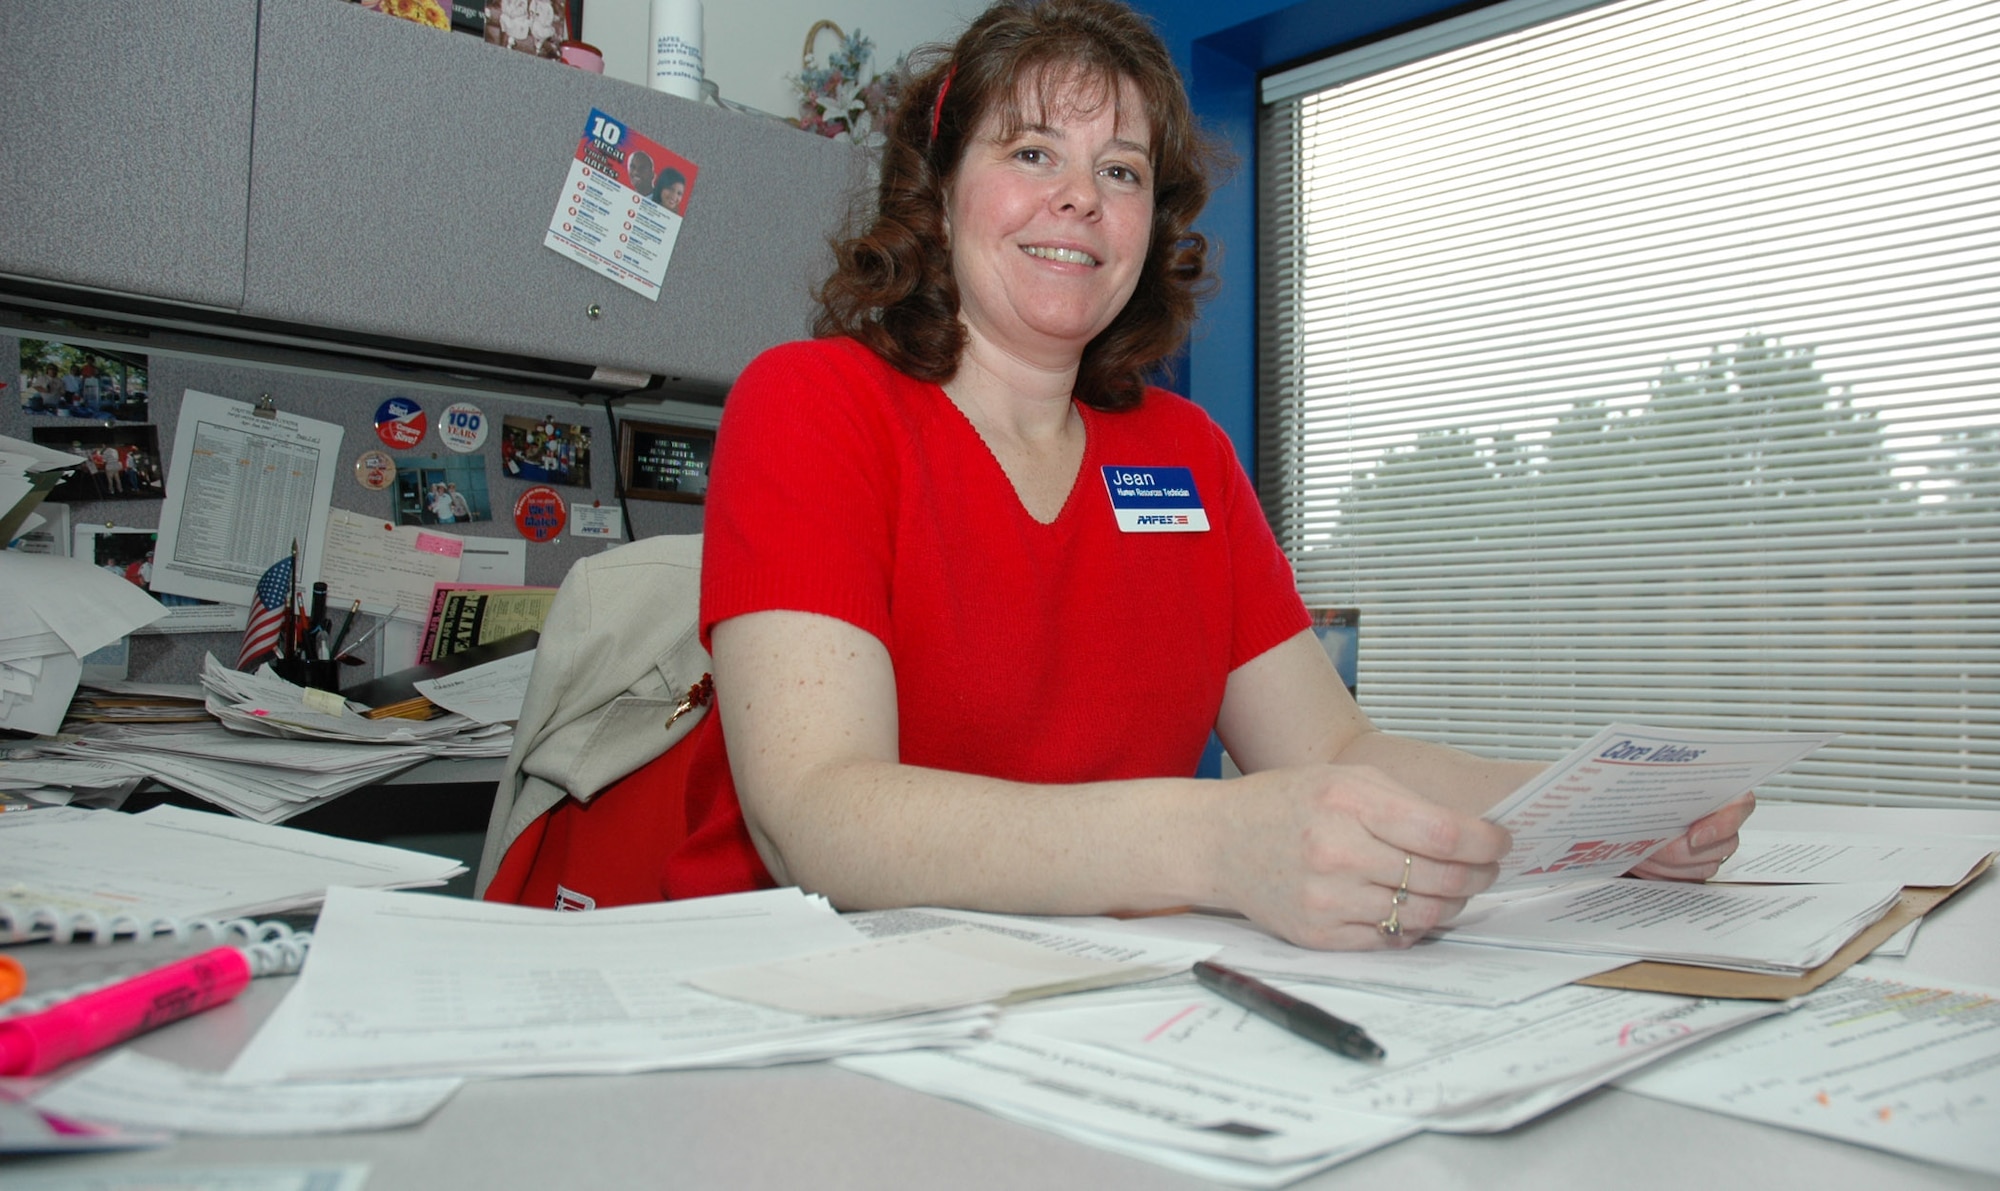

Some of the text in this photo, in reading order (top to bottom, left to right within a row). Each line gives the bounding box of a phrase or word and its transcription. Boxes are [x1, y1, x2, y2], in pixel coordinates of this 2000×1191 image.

[592, 117, 620, 146] 10
[594, 138, 625, 160] great
[449, 412, 480, 431] 100
[447, 426, 478, 440] YEARS
[1113, 470, 1156, 486] Jean
[1117, 488, 1190, 498] Human Resources Technician
[525, 516, 558, 528] Match
[1137, 516, 1174, 525] AAFES
[434, 590, 448, 616] Idaho
[448, 598, 461, 620] Idaho
[1600, 740, 1707, 763] Core Values
